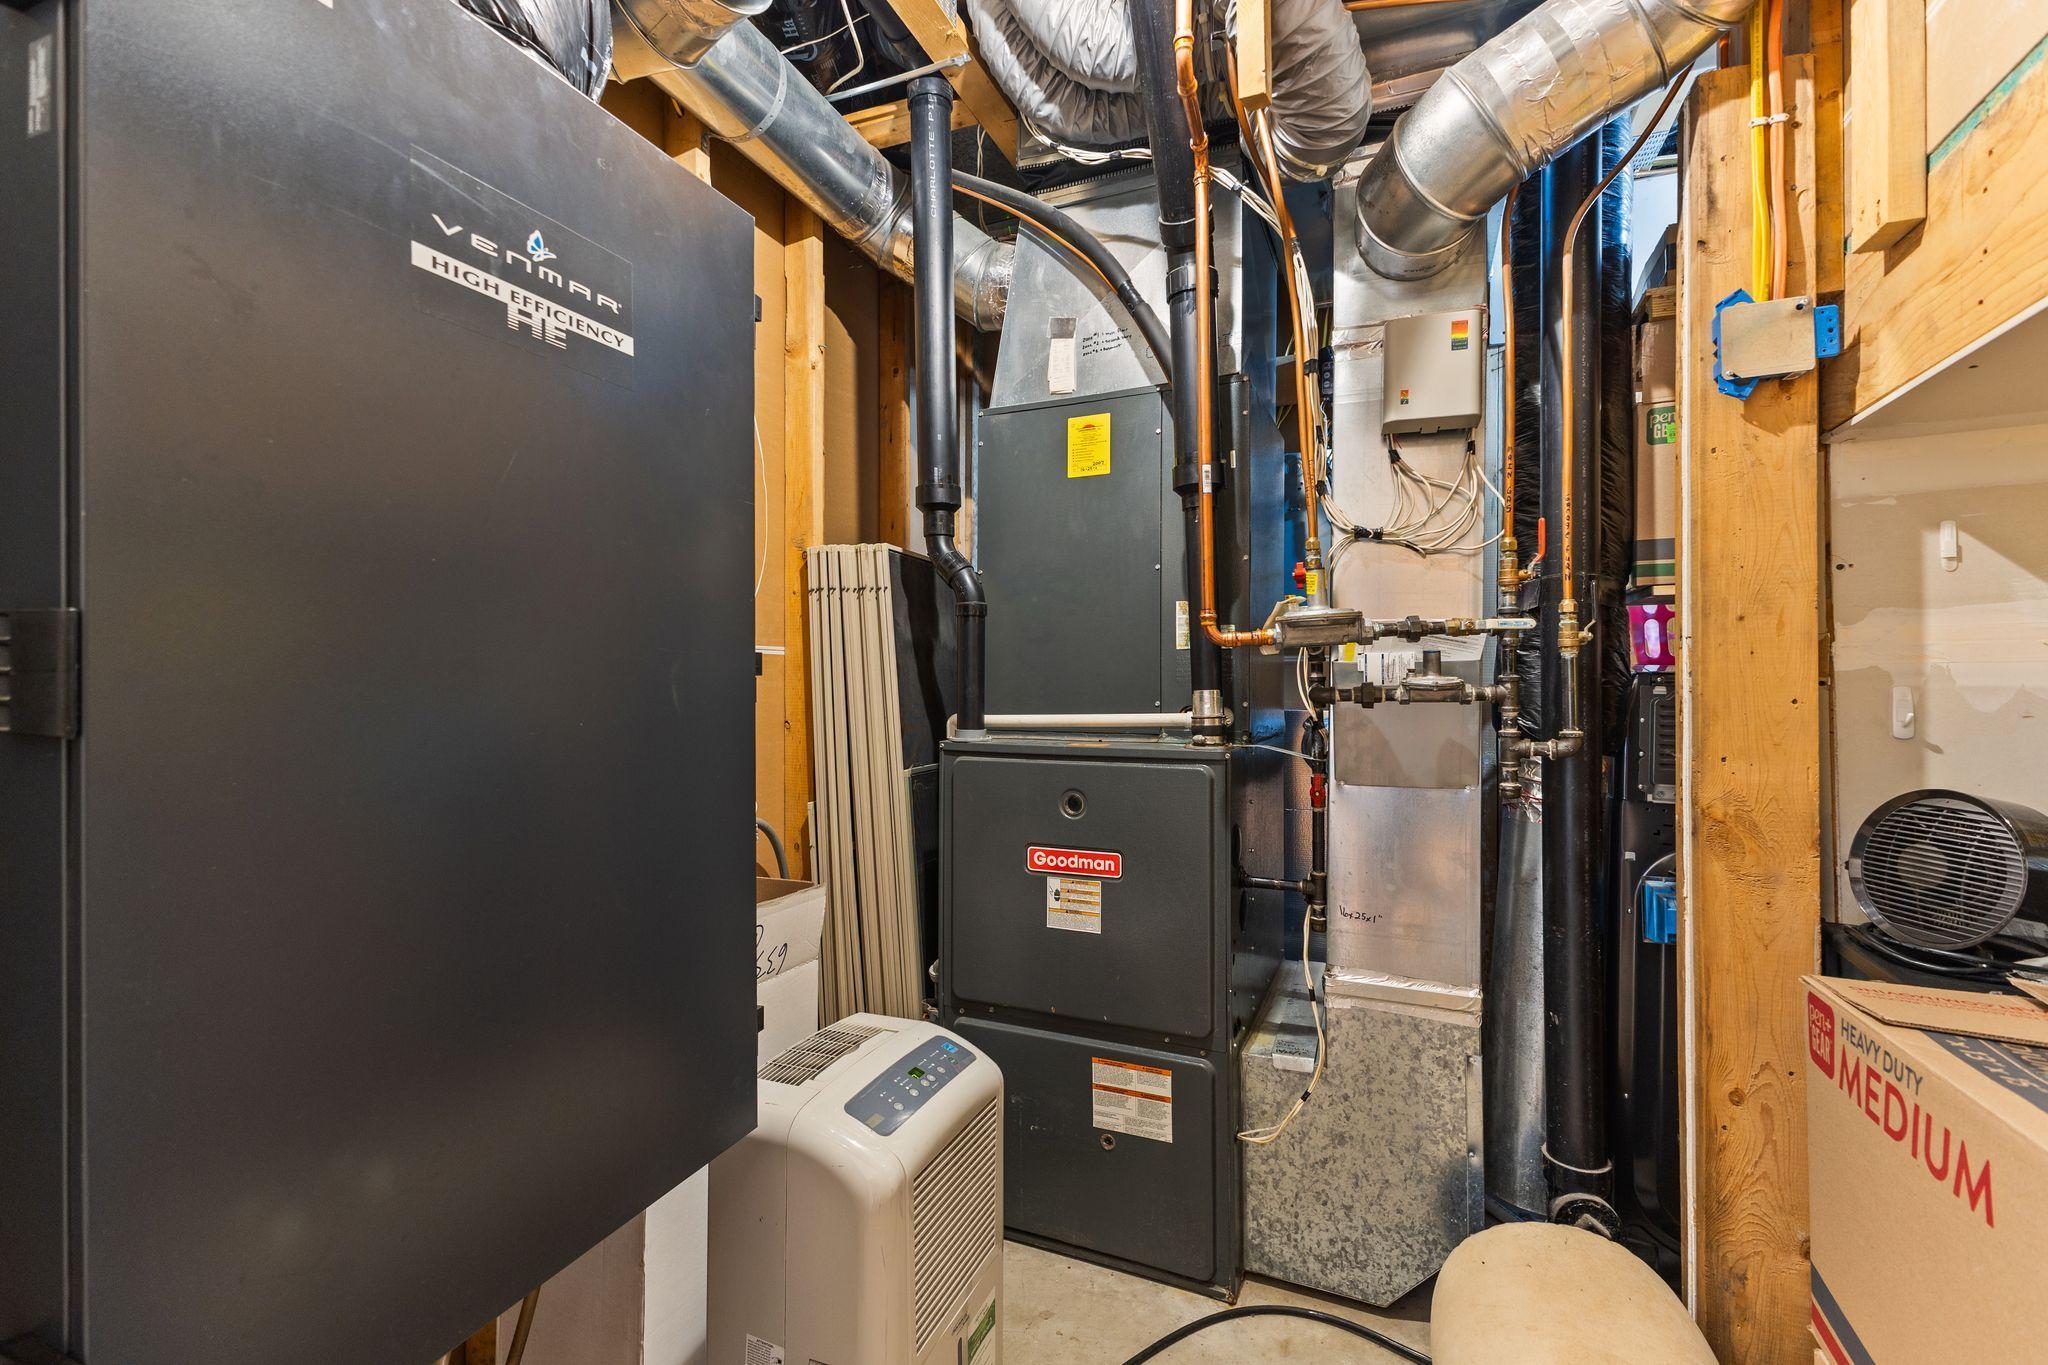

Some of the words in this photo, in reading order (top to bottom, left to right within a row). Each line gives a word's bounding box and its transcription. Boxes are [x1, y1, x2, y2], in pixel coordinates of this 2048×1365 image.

[431, 213, 622, 315] VENMAR
[432, 255, 500, 297] HIGH
[510, 289, 625, 348] EFFICIENCY
[1033, 851, 1116, 872] Goodman
[1811, 1024, 1832, 1065] GEAR
[1841, 1018, 1882, 1064] HEAVY
[1883, 1050, 1924, 1097] DUTY
[1838, 1044, 1995, 1229] MEDIUM
